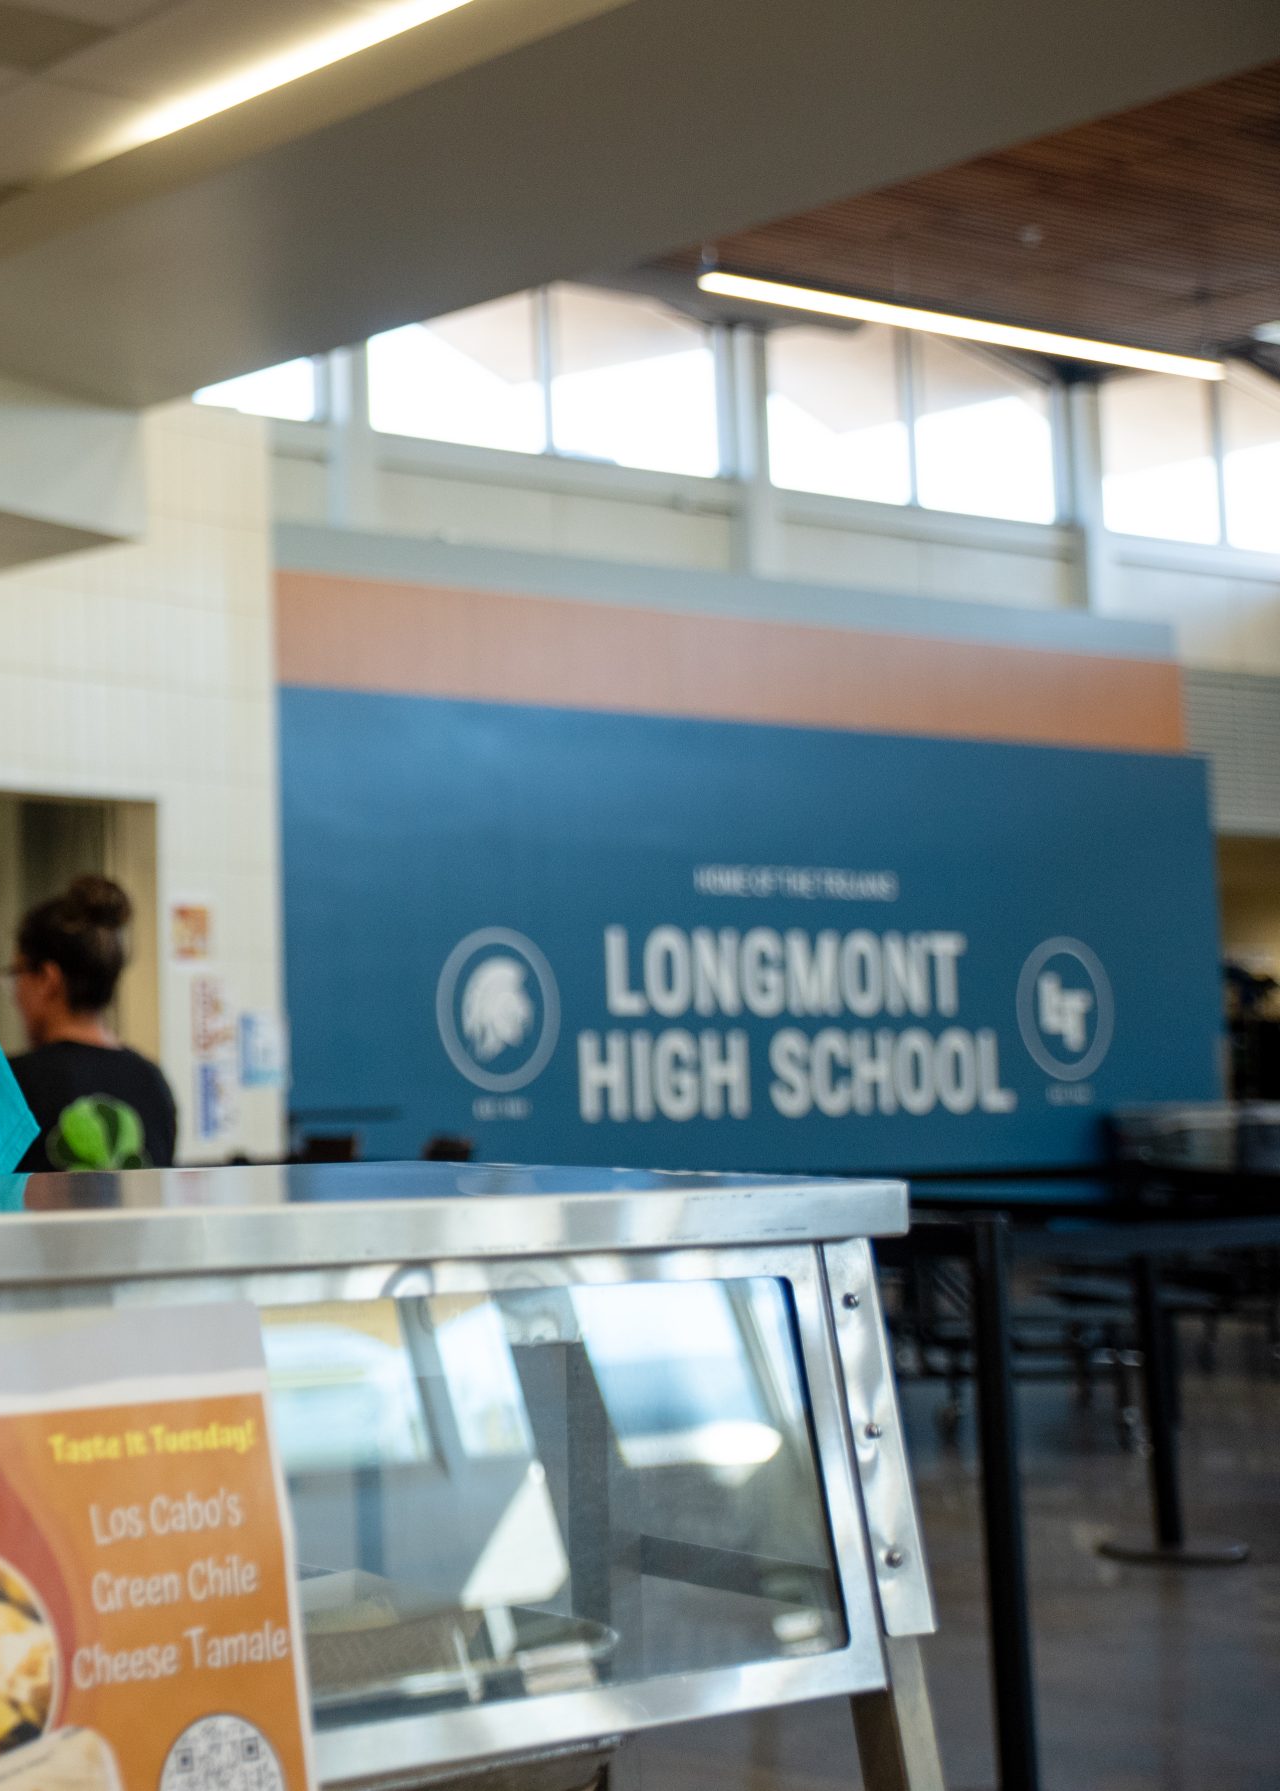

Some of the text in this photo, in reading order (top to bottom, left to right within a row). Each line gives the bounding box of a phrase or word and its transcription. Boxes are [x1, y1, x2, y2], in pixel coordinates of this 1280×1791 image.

[604, 923, 968, 1018] LONGMONT
[577, 1026, 1017, 1123] HIGH SCHOOL
[48, 1432, 120, 1464] Taste
[149, 1418, 256, 1456] Tuesday!
[89, 1487, 244, 1545] Los Cabo's
[91, 1554, 258, 1614] Green Chile
[72, 1620, 289, 1690] Cheese Tamale
